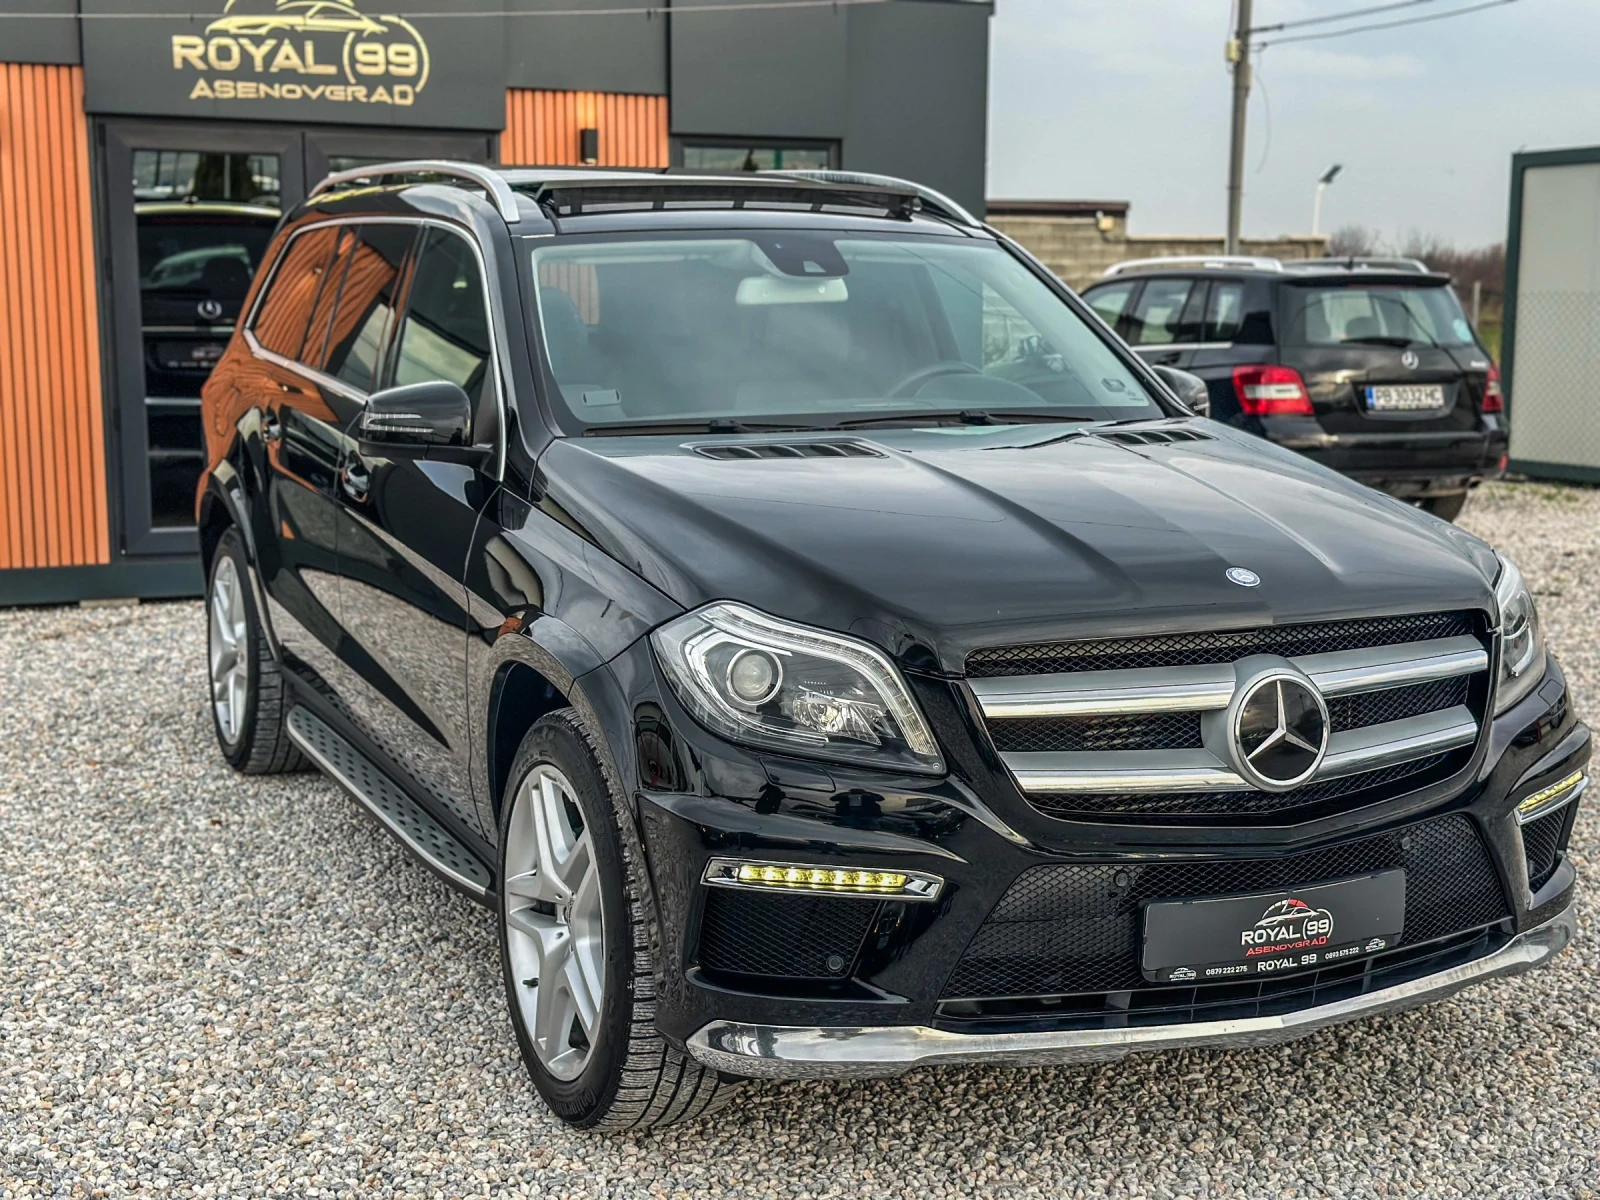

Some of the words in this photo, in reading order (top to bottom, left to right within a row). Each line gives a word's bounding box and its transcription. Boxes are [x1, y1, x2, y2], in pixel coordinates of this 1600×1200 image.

[171, 35, 338, 75] ROYAL
[189, 77, 415, 106] ASENOVGRAD
[1241, 925, 1301, 945] ROYAL
[1245, 935, 1328, 957] ASENOVGRAD
[1222, 966, 1235, 974] 222
[1235, 965, 1248, 973] 275
[1257, 957, 1298, 972] ROYAL
[1300, 953, 1317, 965] 99
[1349, 946, 1360, 954] 222
